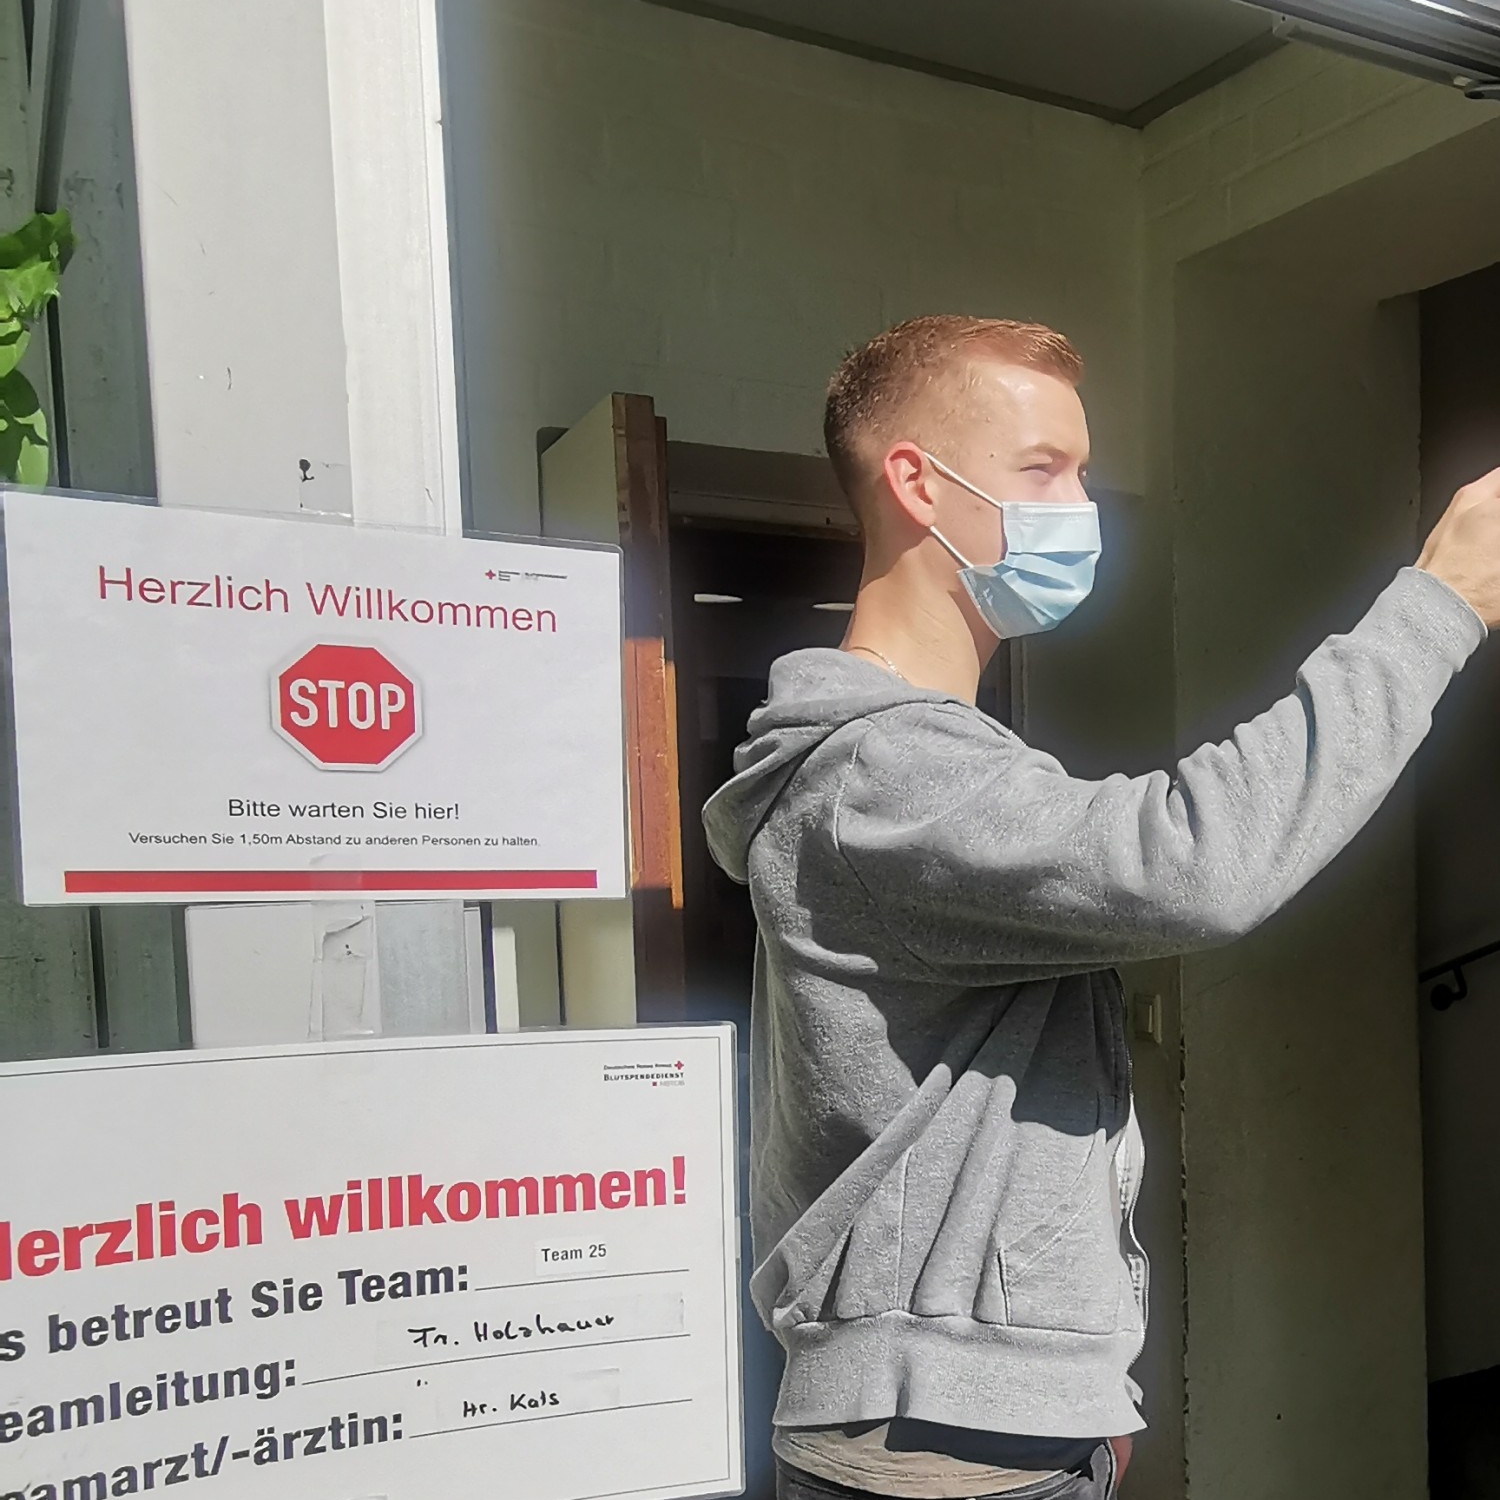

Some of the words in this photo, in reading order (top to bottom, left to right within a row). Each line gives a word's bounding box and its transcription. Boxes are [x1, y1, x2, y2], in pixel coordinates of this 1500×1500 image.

[98, 565, 290, 613] Herzlich
[305, 582, 558, 633] Willkommen
[289, 678, 406, 731] STOP
[228, 799, 281, 818] Bitte
[288, 801, 365, 820] warten
[372, 802, 407, 820] Sie
[414, 803, 460, 820] hier!
[128, 832, 207, 846] Versuchen
[211, 833, 235, 845] Sie
[286, 834, 342, 846] Abstand
[345, 838, 362, 847] zu
[365, 836, 418, 847] anderen
[422, 836, 481, 848] Personen
[484, 838, 499, 848] zu
[0, 1193, 263, 1281] erzlich
[284, 1156, 686, 1240] willkommen!
[541, 1247, 583, 1263] Team
[588, 1243, 607, 1258] 25
[48, 1287, 234, 1354] betreut
[251, 1277, 323, 1318] Sie
[337, 1264, 468, 1306] Team:
[0, 1358, 296, 1444] eamleitung:
[462, 1400, 498, 1418] Hr.
